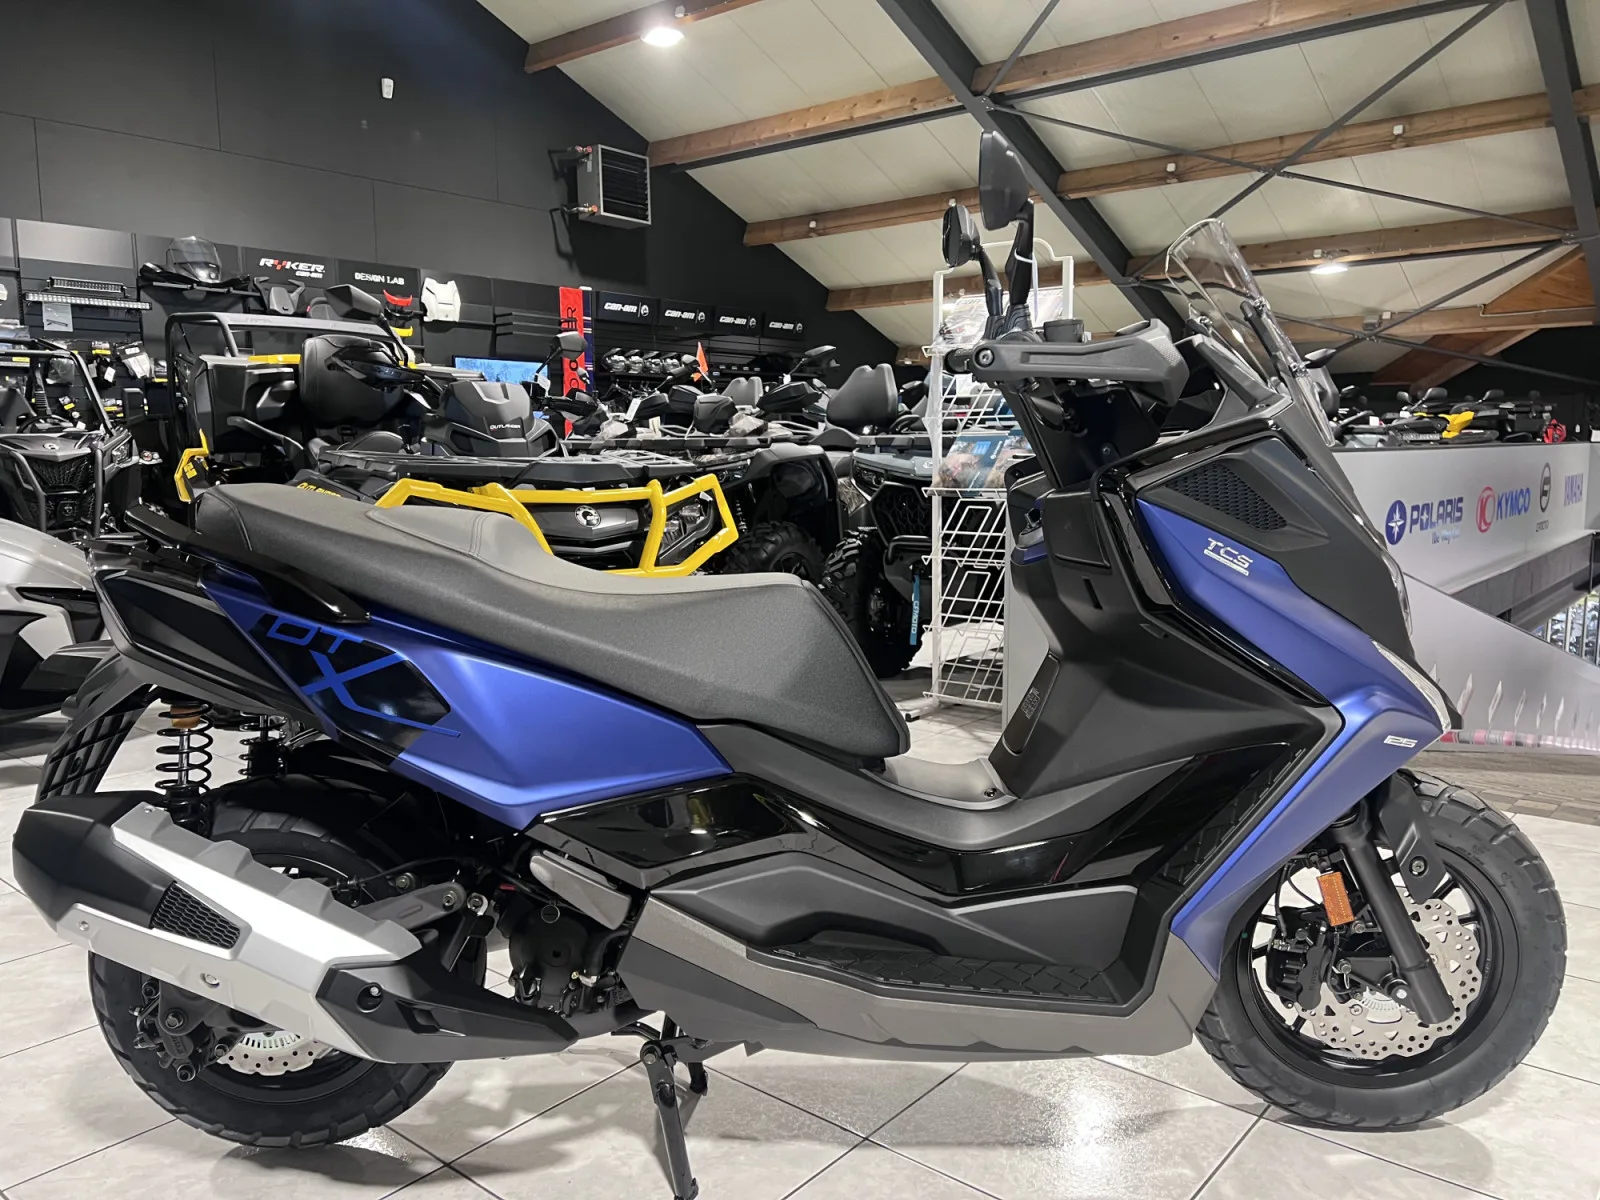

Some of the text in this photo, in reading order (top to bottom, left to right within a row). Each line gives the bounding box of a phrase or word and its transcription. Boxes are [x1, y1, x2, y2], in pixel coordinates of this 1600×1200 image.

[259, 258, 325, 273] RYKER
[355, 272, 405, 285] DESIGN LAB
[604, 302, 637, 313] can-am
[665, 309, 695, 320] can-am
[719, 315, 746, 325] can-am
[769, 321, 794, 330] can-am
[1496, 488, 1531, 520] KYMCO
[1409, 497, 1464, 534] POLARIS
[1208, 537, 1253, 569] TCS
[911, 600, 919, 634] CFMOTO
